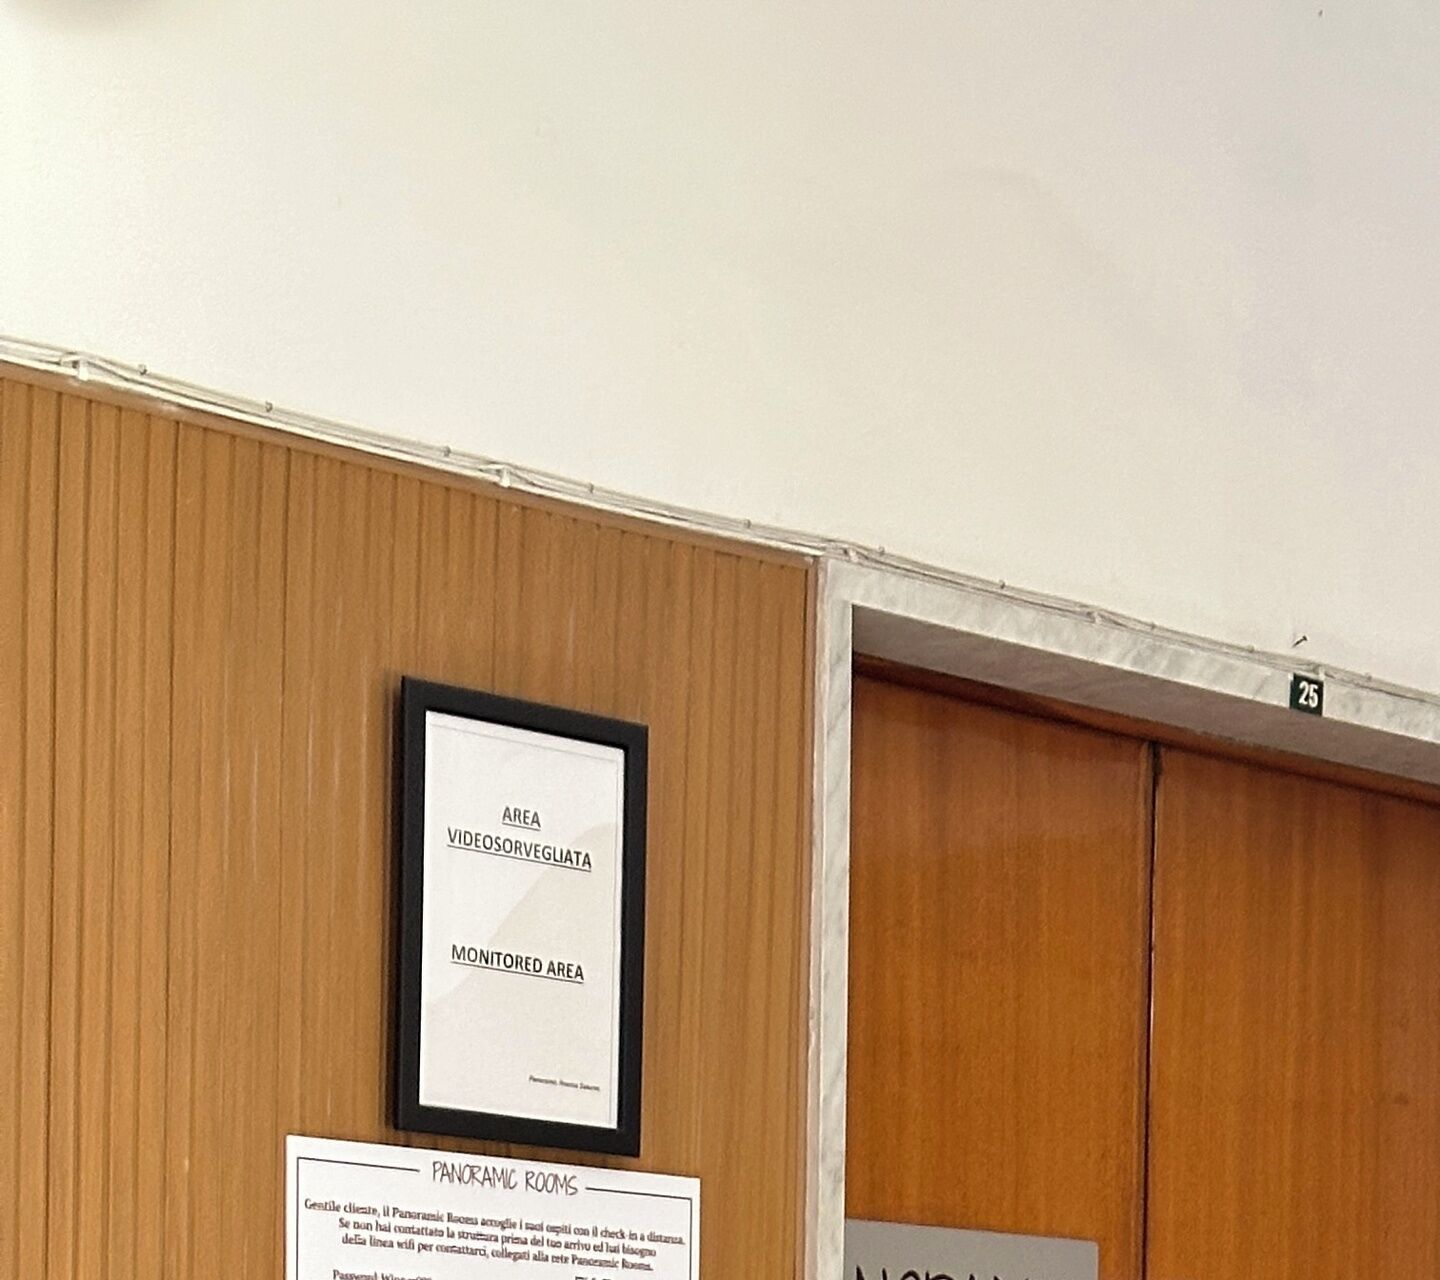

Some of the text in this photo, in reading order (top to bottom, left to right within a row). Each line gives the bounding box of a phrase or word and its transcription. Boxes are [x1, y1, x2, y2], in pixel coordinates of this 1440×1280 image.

[1298, 680, 1319, 708] 25
[502, 806, 541, 829] AREA
[447, 827, 592, 870] VIDEOSORVEGLIATA
[451, 944, 584, 982] MONITORED AREA
[432, 1160, 578, 1196] PANORAMIC ROOMS
[532, 1250, 549, 1262] alla
